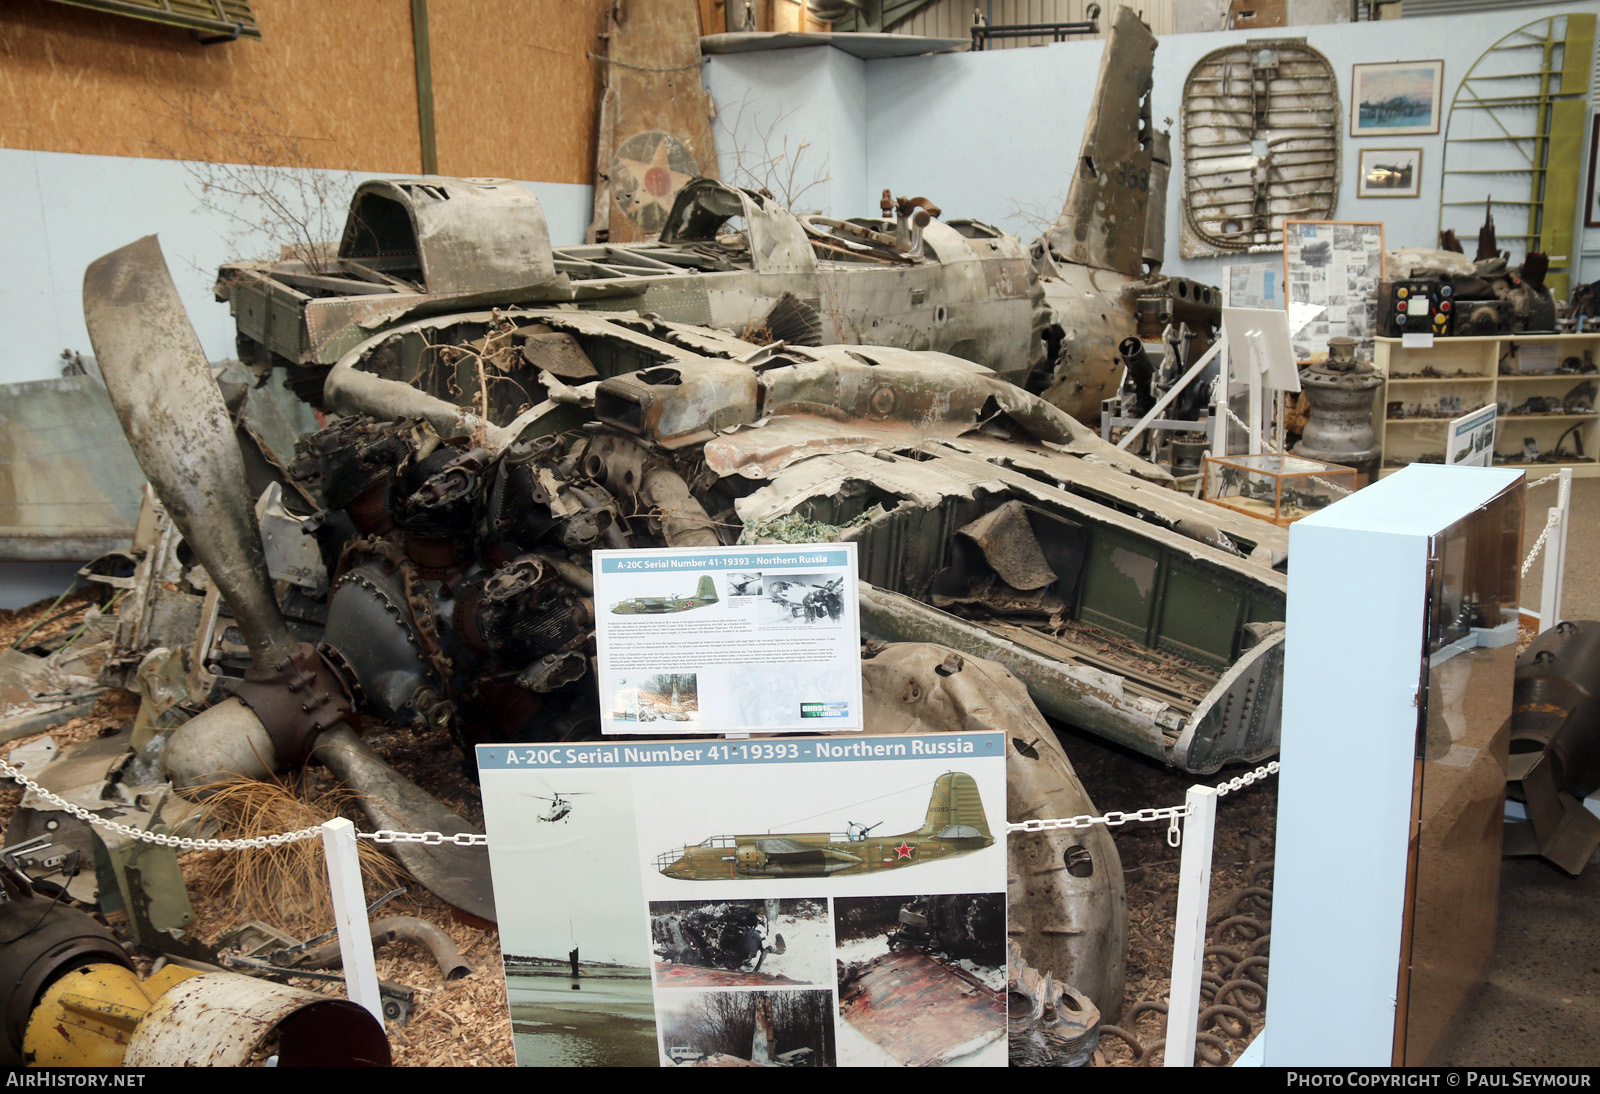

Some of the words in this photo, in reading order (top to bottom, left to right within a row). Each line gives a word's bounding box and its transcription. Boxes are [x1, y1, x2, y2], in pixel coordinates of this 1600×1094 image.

[617, 560, 643, 569] A-20C
[644, 559, 669, 569] Serial
[670, 558, 706, 568] Number
[708, 557, 750, 567] 41-19393
[756, 555, 797, 565] Northern
[799, 554, 828, 564] Russia
[506, 749, 561, 765] A-20C
[566, 747, 620, 764] Serial
[624, 746, 703, 763] Number
[707, 743, 800, 761] 41-19393
[816, 740, 906, 758] Northern
[911, 738, 975, 755] Russia
